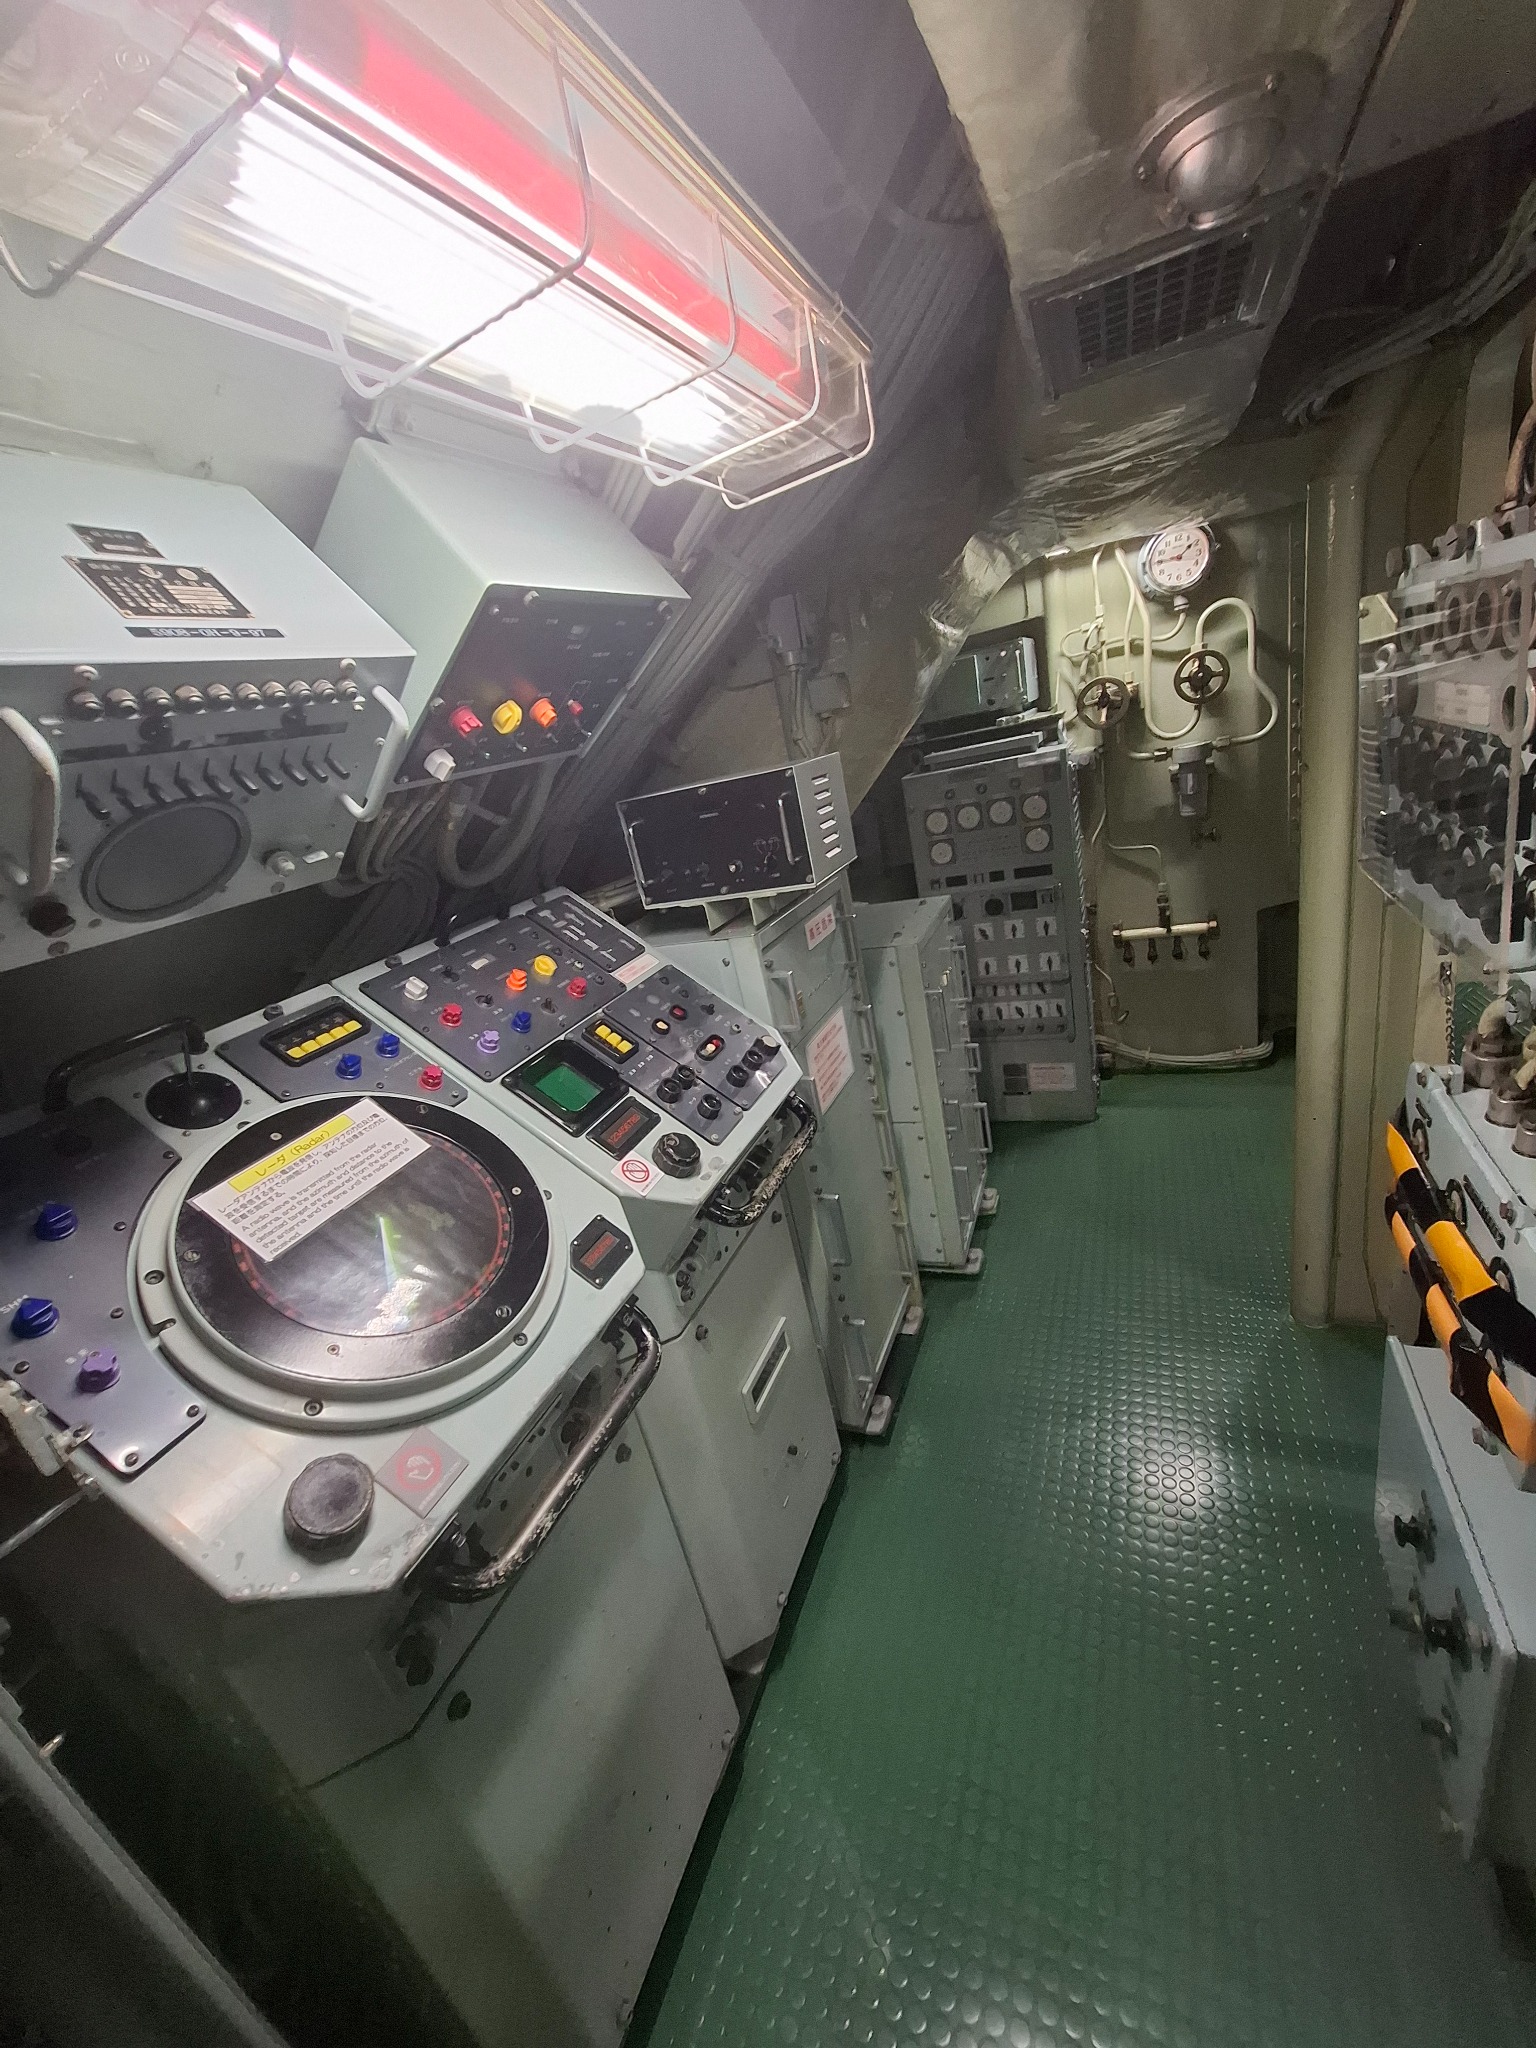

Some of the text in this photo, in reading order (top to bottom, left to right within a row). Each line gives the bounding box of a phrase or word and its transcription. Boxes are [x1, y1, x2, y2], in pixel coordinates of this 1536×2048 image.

[249, 1213, 270, 1227] radio
[269, 1200, 290, 1213] wave
[296, 1170, 334, 1196] transmitted
[333, 1160, 350, 1171] from
[360, 1142, 377, 1155] radar
[255, 1220, 288, 1243] detected
[287, 1205, 311, 1221] target
[322, 1176, 354, 1198] measured
[352, 1166, 369, 1177] from
[379, 1143, 402, 1160] azimuth
[276, 1218, 307, 1239] antenna
[332, 1189, 348, 1200] time
[347, 1179, 362, 1190] until
[372, 1162, 388, 1173] radio
[388, 1150, 404, 1163] wave
[309, 1179, 336, 1197] azimuth
[349, 1153, 375, 1171] distance
